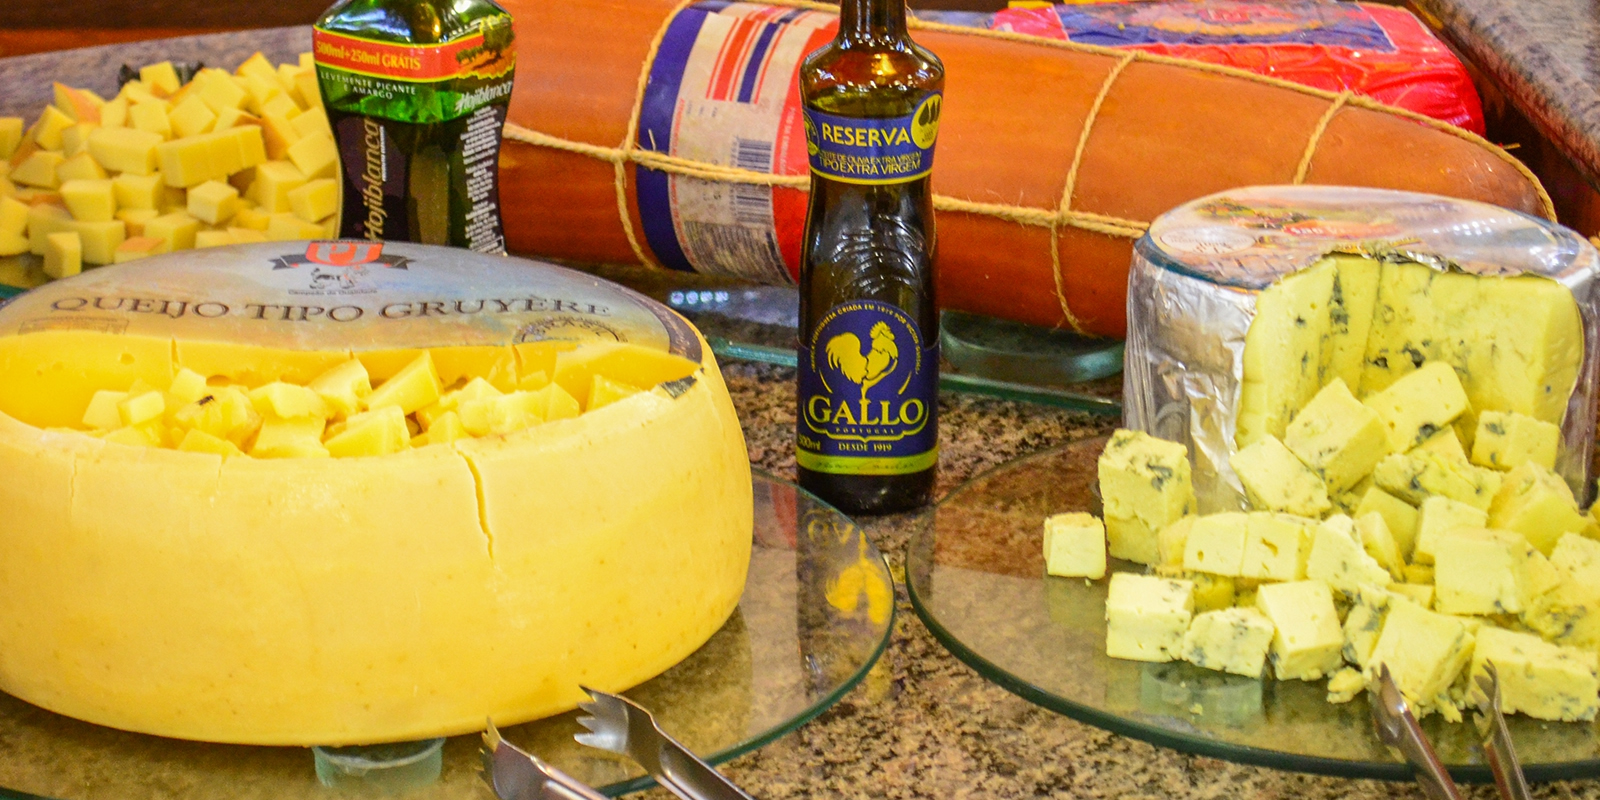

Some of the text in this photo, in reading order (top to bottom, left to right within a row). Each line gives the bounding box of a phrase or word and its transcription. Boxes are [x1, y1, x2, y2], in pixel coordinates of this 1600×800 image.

[382, 54, 421, 70] GRÁTIS
[320, 71, 416, 96] LEVEMENTE PICANTE
[343, 84, 393, 100] E AMARGO
[821, 122, 911, 147] RESERVA
[840, 161, 879, 175] EXTRA
[879, 159, 921, 175] VIRGEM
[50, 294, 611, 322] QUEIJO TIPO GRUYÈRE
[837, 303, 863, 316] CRIADA
[864, 303, 875, 311] EM
[808, 394, 924, 426] GALLO
[835, 426, 895, 435] PORTUGAL
[838, 442, 893, 452] DESDE 1919
